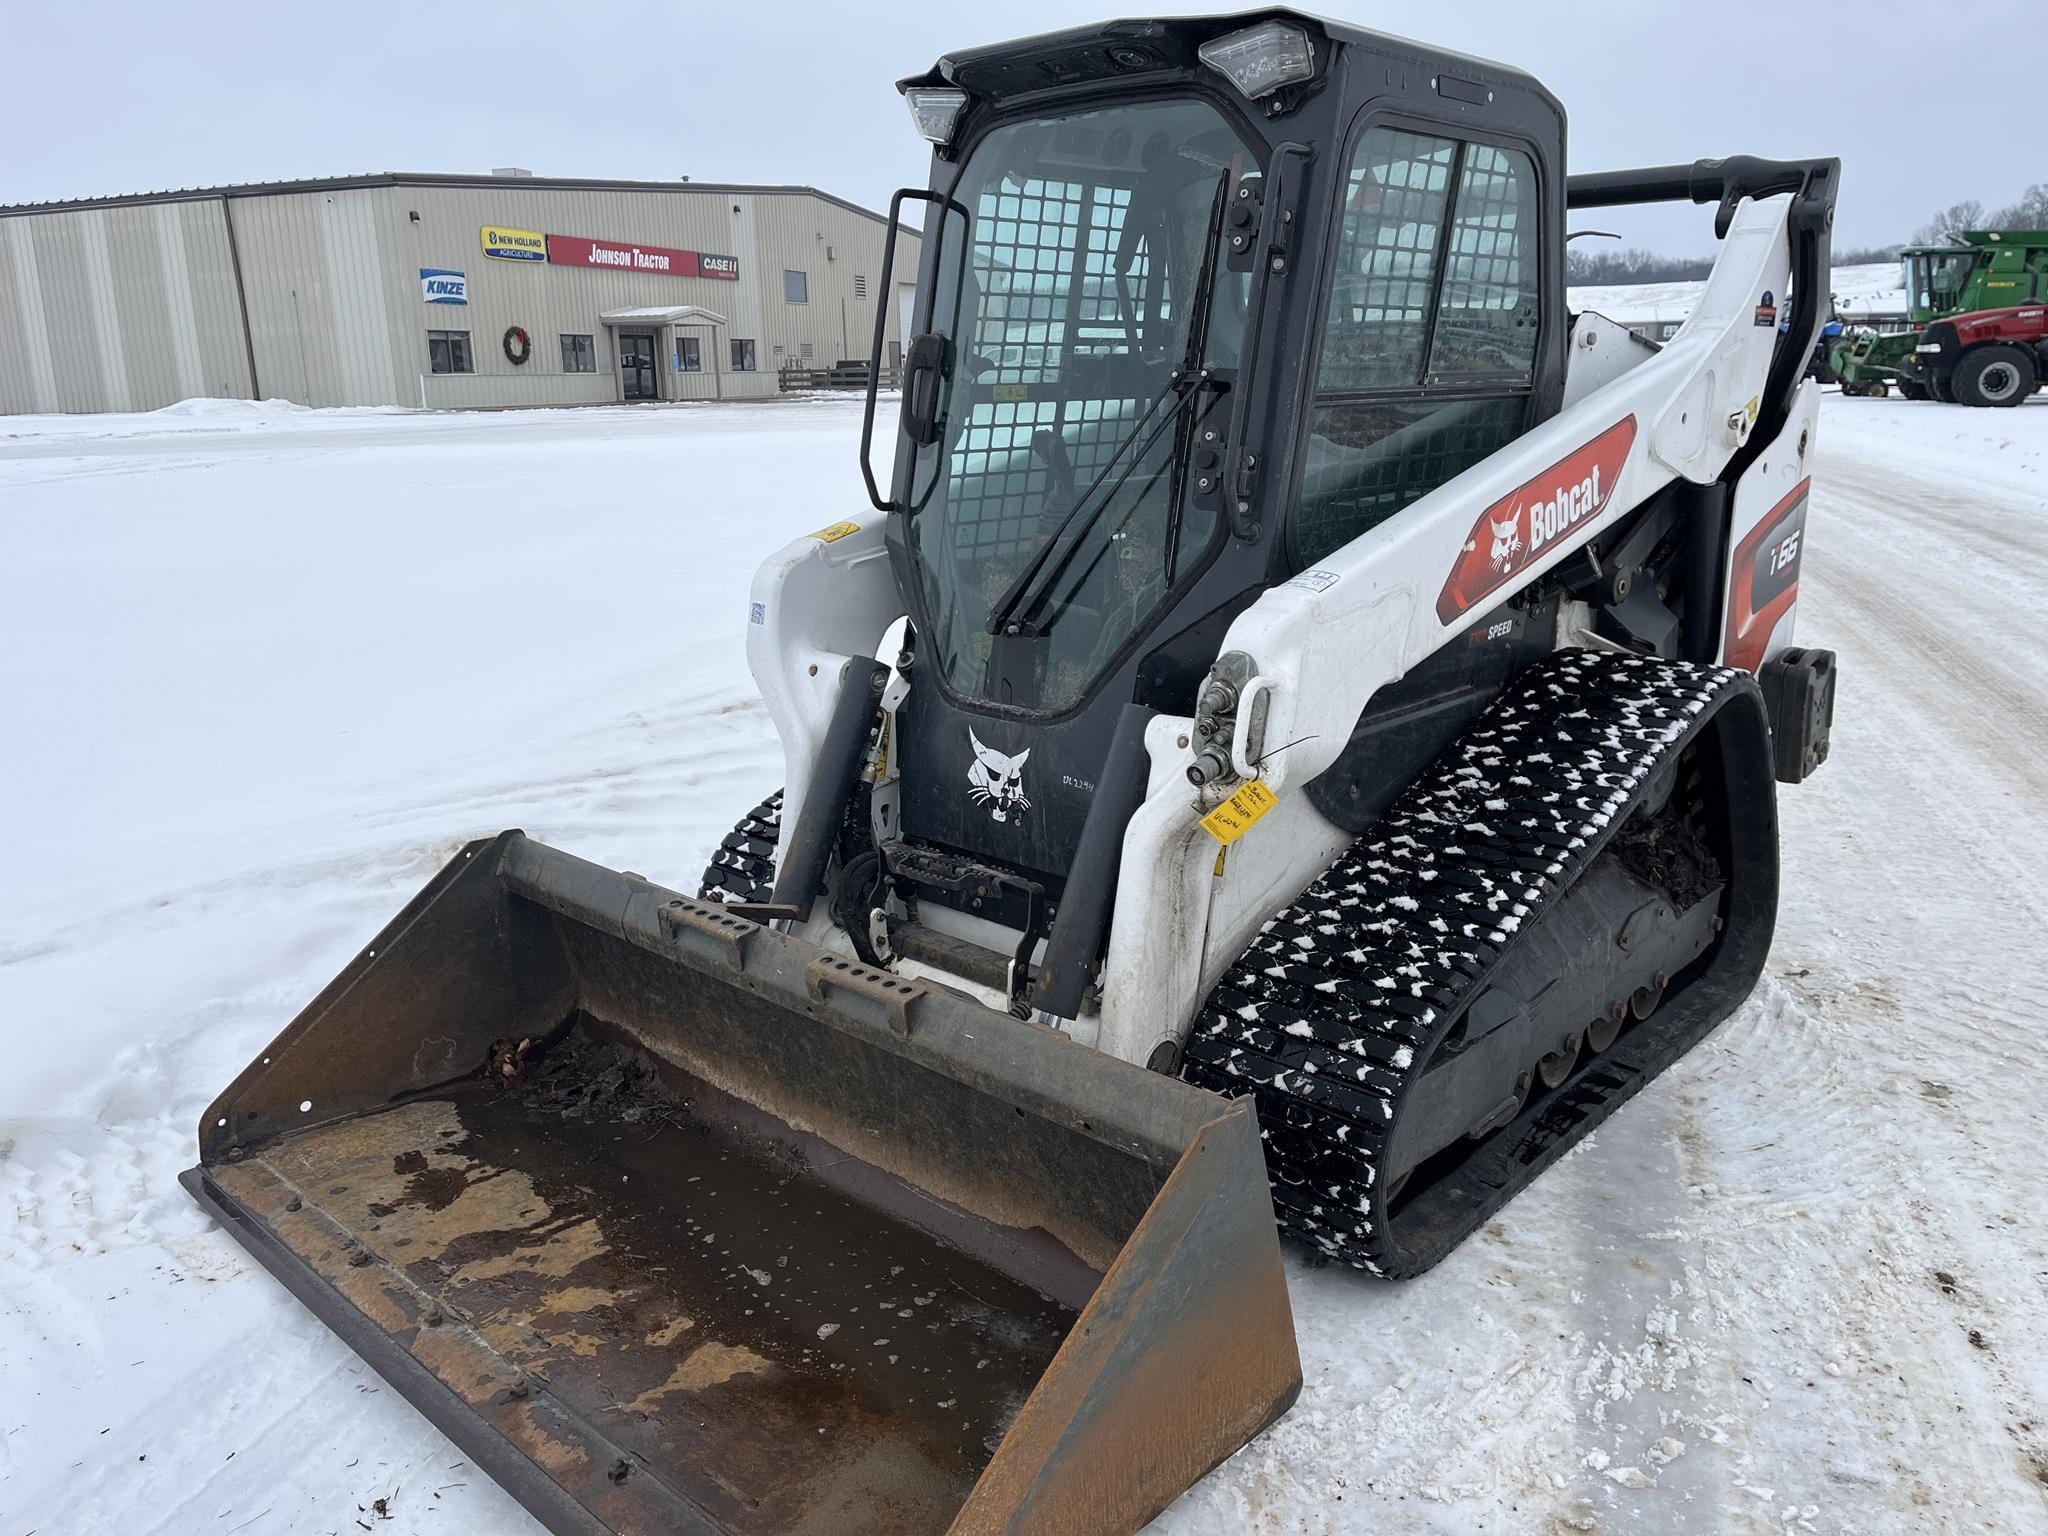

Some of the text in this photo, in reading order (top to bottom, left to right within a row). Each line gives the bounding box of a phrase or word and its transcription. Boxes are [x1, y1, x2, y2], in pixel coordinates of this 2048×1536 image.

[499, 236, 542, 248] NEW HOLLAND
[588, 243, 670, 270] JOHNSON TRACTOR
[427, 280, 464, 295] KINZE
[1530, 464, 1600, 552] Bobcat
[1487, 620, 1512, 640] SPEED
